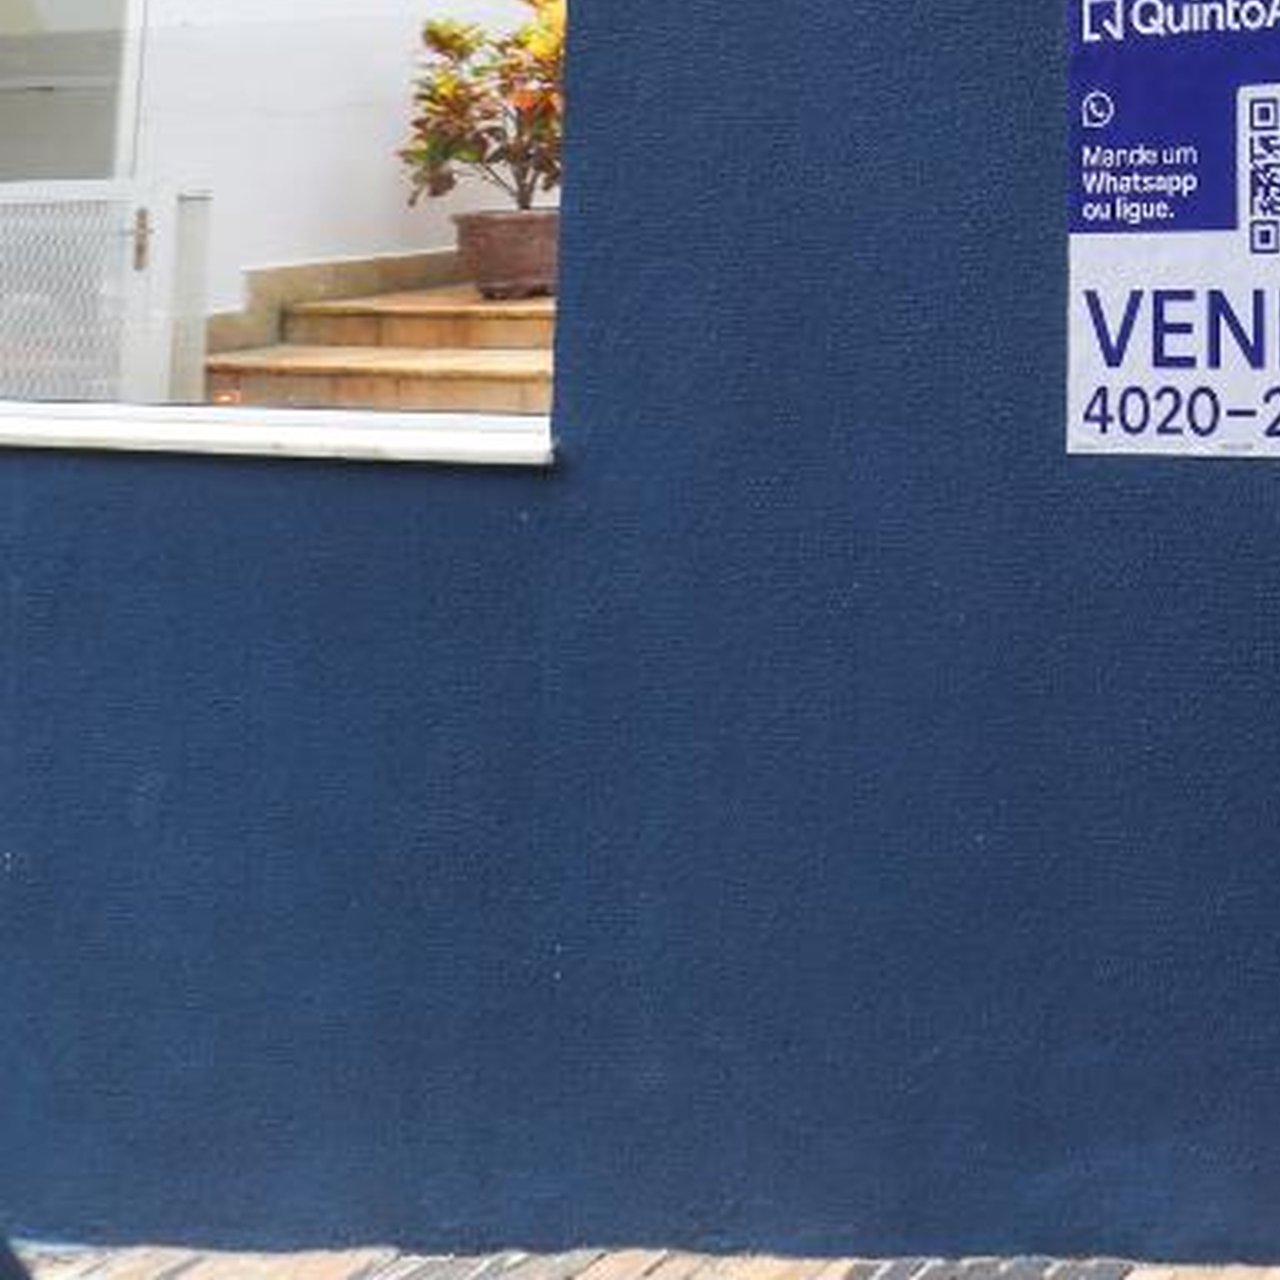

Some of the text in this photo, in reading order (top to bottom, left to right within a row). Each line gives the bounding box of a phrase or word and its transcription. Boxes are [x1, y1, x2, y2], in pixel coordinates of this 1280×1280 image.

[1082, 144, 1198, 167] Mande um
[1082, 172, 1198, 196] Whatsapp
[1082, 197, 1175, 224] ou ligue.
